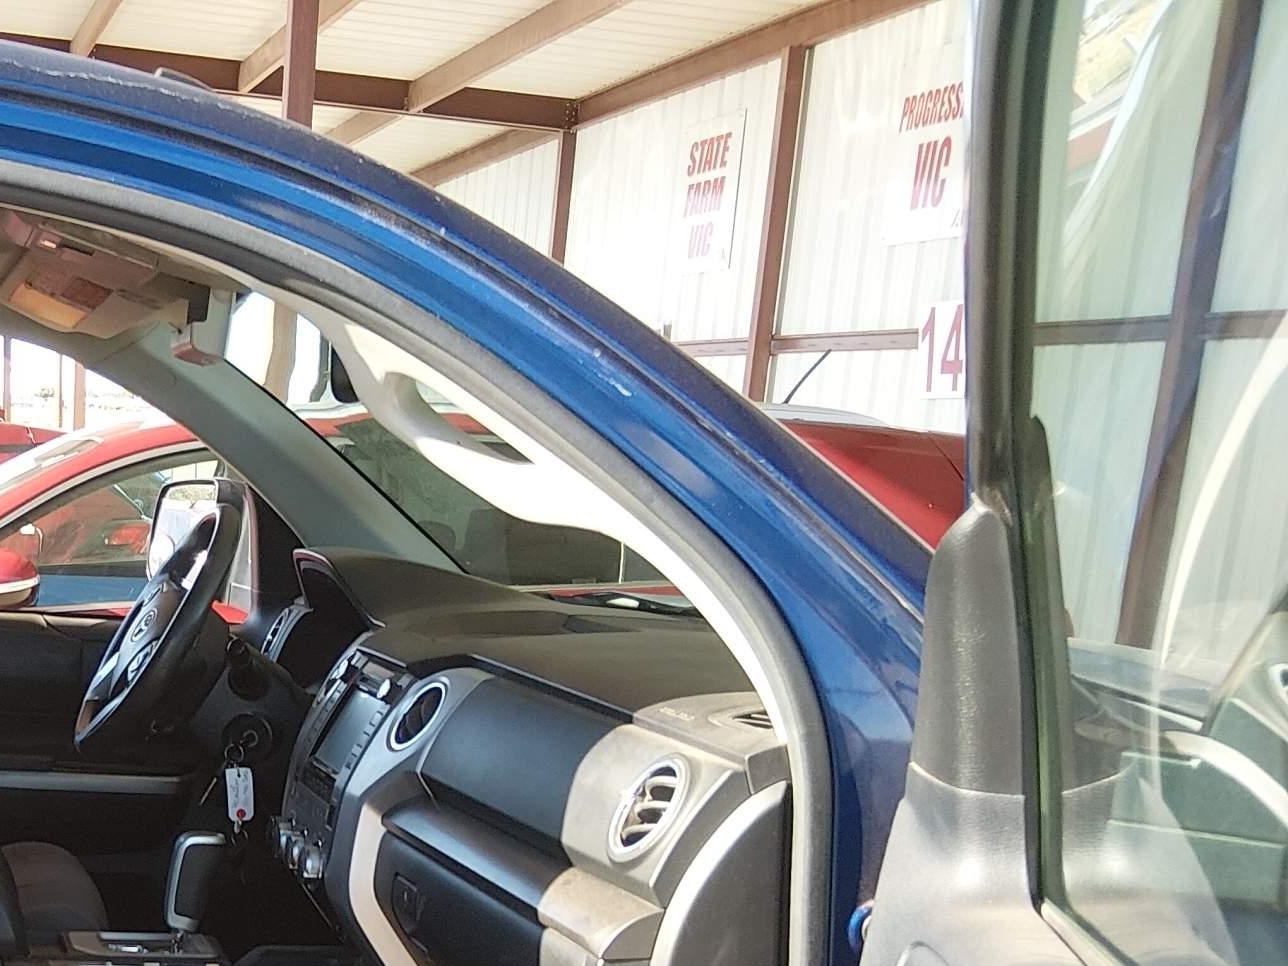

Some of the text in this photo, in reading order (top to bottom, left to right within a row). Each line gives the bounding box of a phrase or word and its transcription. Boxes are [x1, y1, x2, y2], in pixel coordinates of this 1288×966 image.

[899, 81, 964, 133] PROGRESS
[687, 132, 732, 177] STATE
[910, 136, 952, 210] VIC
[683, 176, 726, 218] FARM
[688, 222, 713, 259] VIC
[921, 304, 964, 392] 14
